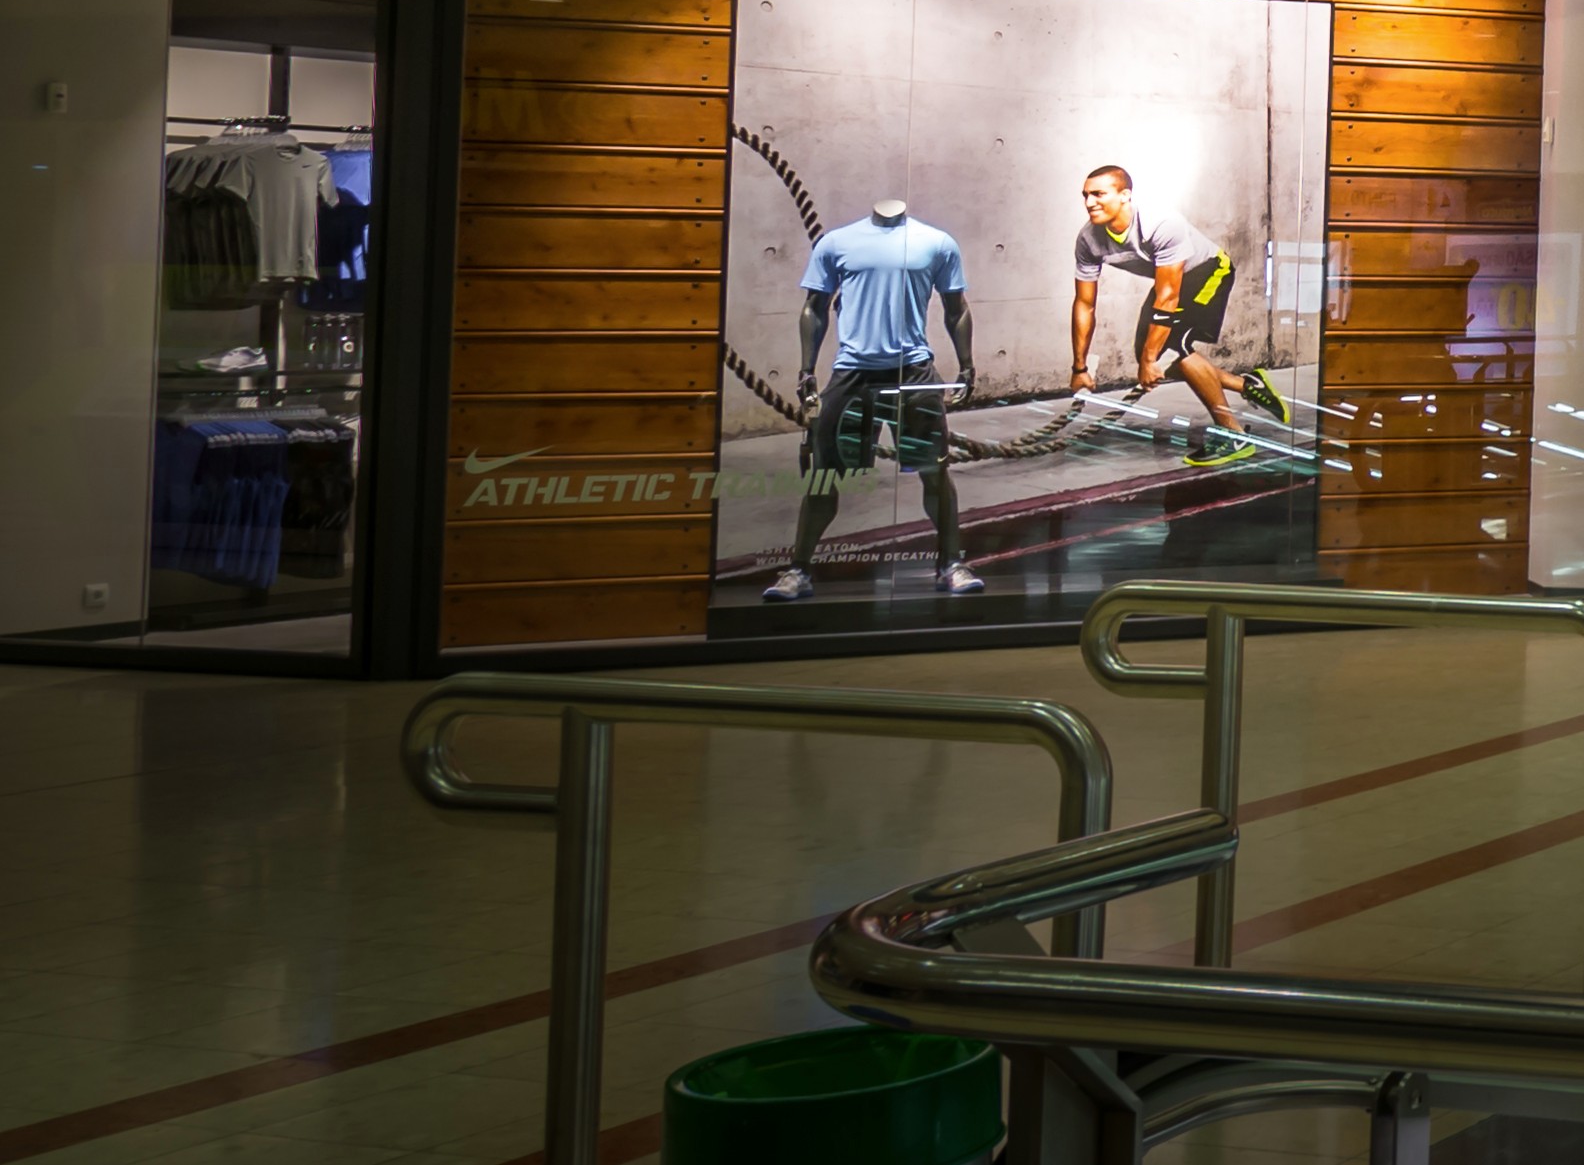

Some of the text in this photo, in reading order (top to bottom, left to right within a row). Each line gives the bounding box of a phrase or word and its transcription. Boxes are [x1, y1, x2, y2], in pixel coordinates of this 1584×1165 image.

[463, 467, 881, 507] ATHLETIC TRAINING
[755, 555, 793, 566] WORL
[810, 551, 880, 565] CHAMPION
